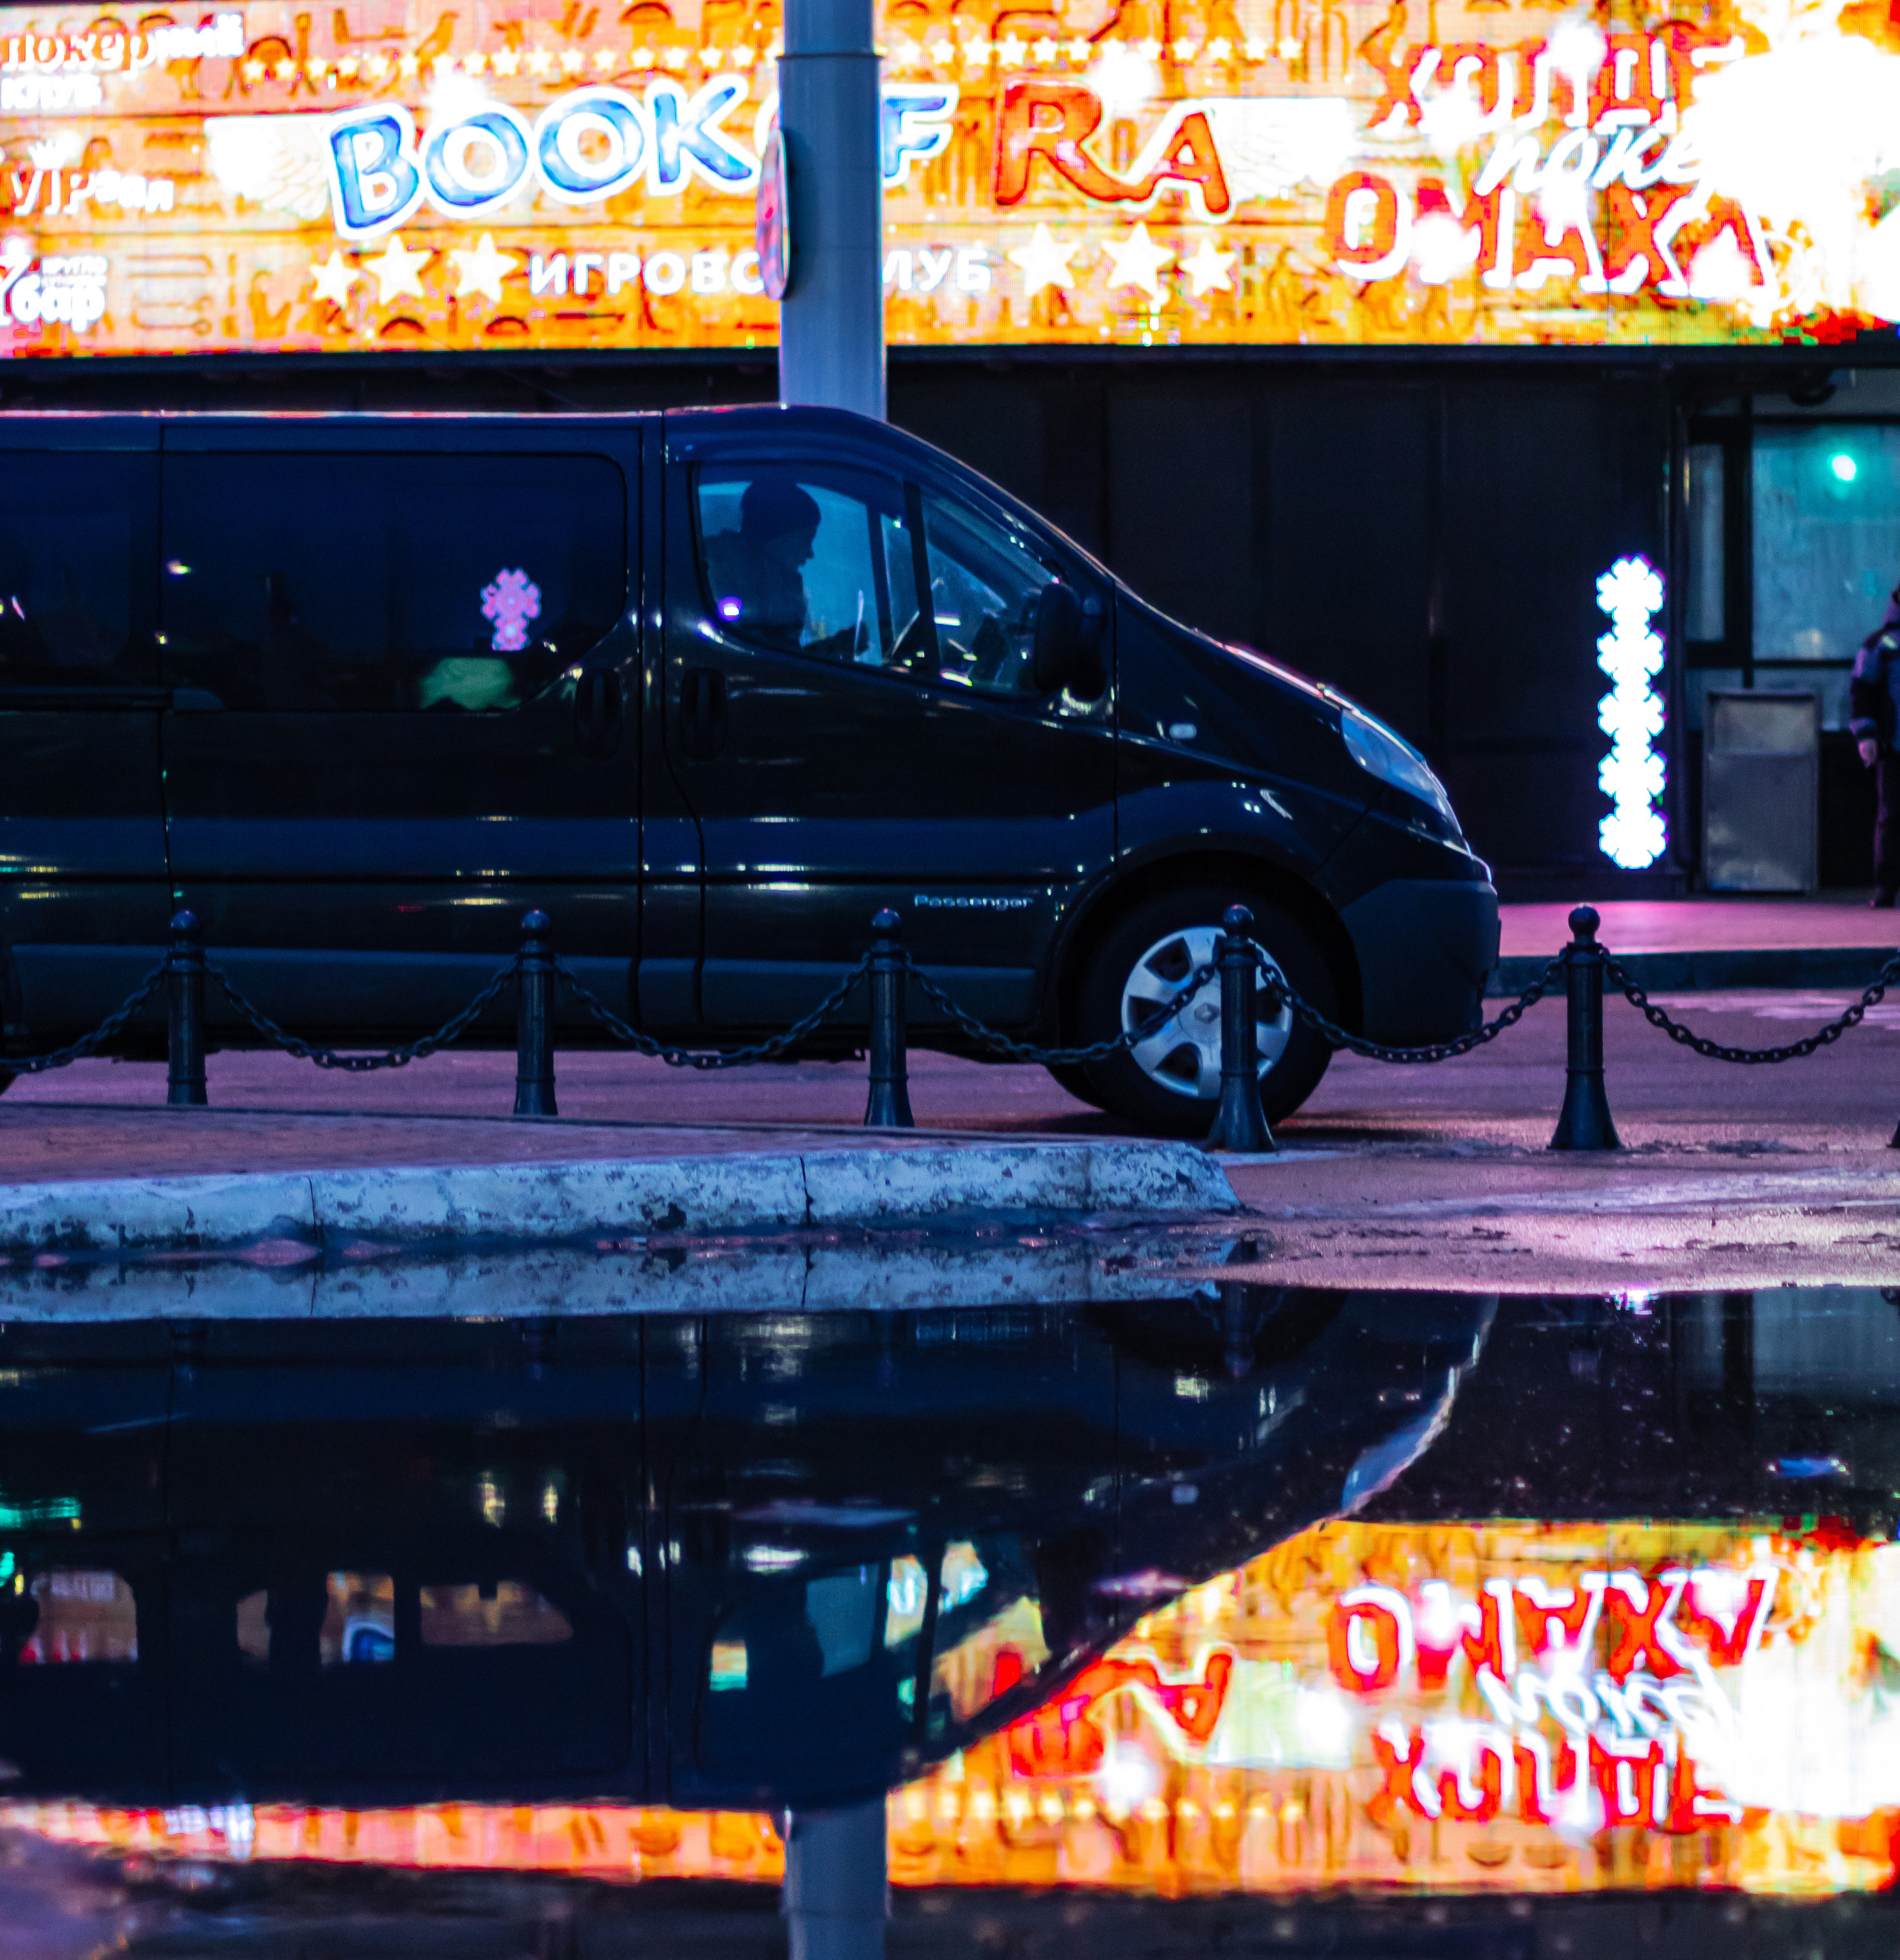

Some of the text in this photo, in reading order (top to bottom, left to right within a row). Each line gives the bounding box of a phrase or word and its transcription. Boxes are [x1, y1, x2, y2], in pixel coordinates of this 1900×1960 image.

[1362, 28, 1746, 137] ХОЛДЕ
[325, 73, 760, 239] BOOK
[995, 77, 1238, 224] RA
[1473, 126, 1706, 196] поке
[1, 166, 97, 214] VIP
[528, 248, 992, 297] ИГРОВО ЛУБ
[914, 895, 1033, 912] Passenger
